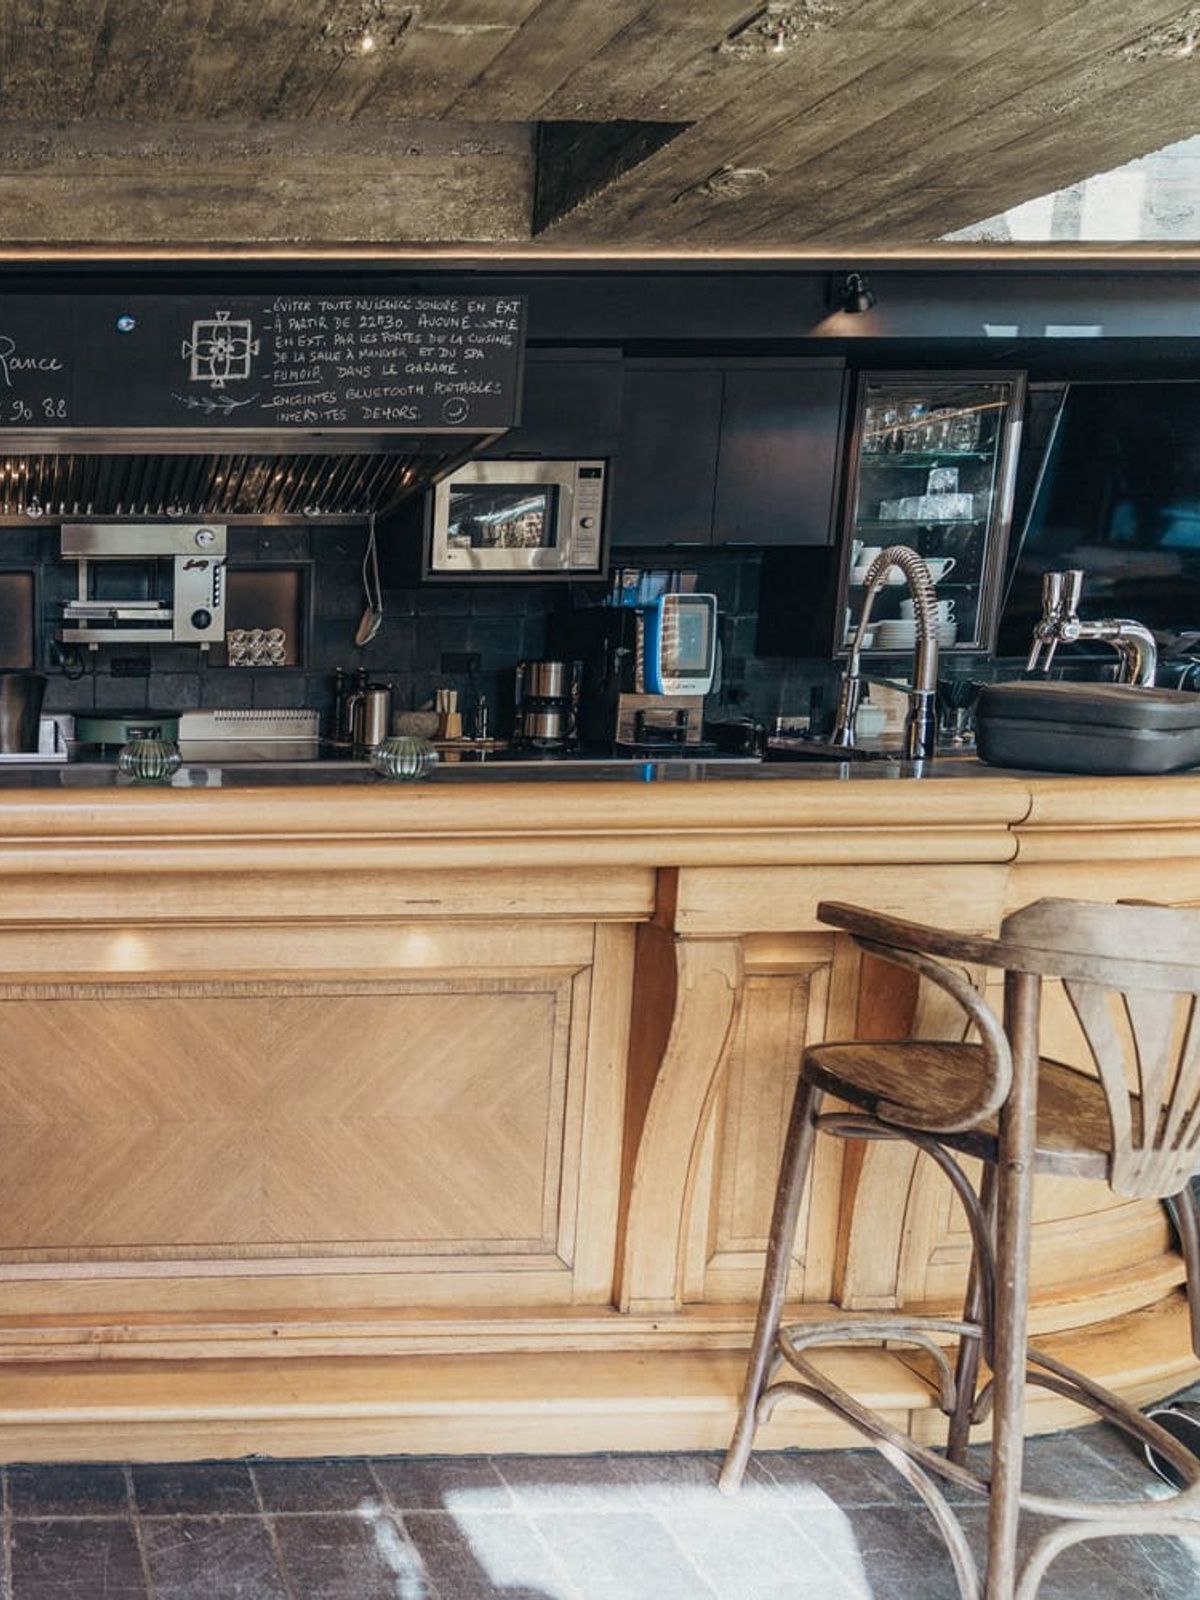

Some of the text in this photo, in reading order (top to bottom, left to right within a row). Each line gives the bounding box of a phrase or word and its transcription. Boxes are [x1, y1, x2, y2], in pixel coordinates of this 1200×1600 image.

[318, 300, 352, 311] TOUTE
[415, 299, 459, 312] SONORE
[467, 301, 486, 313] EN
[496, 300, 521, 314] EXT
[288, 317, 328, 331] PARTIR
[334, 317, 351, 329] DE
[418, 313, 471, 330] AUCUNE
[275, 336, 293, 348] EN
[334, 333, 355, 346] PAR
[360, 333, 378, 344] LES
[381, 332, 422, 345] PORTES
[449, 335, 463, 345] LA
[272, 352, 287, 365] DE
[293, 352, 305, 363] LA
[310, 351, 340, 362] SALLE
[358, 348, 407, 360] MANGER
[419, 347, 435, 357] ET
[438, 347, 456, 358] DU
[463, 348, 484, 360] SPA
[336, 365, 371, 378] DANS
[382, 364, 398, 375] LE
[272, 391, 337, 407] ENCEINTES
[346, 386, 424, 400] BLUETOOTH
[434, 382, 502, 395] PORTABLES
[10, 400, 33, 422] 90
[42, 397, 67, 419] 88
[276, 409, 347, 423] INTERDITES
